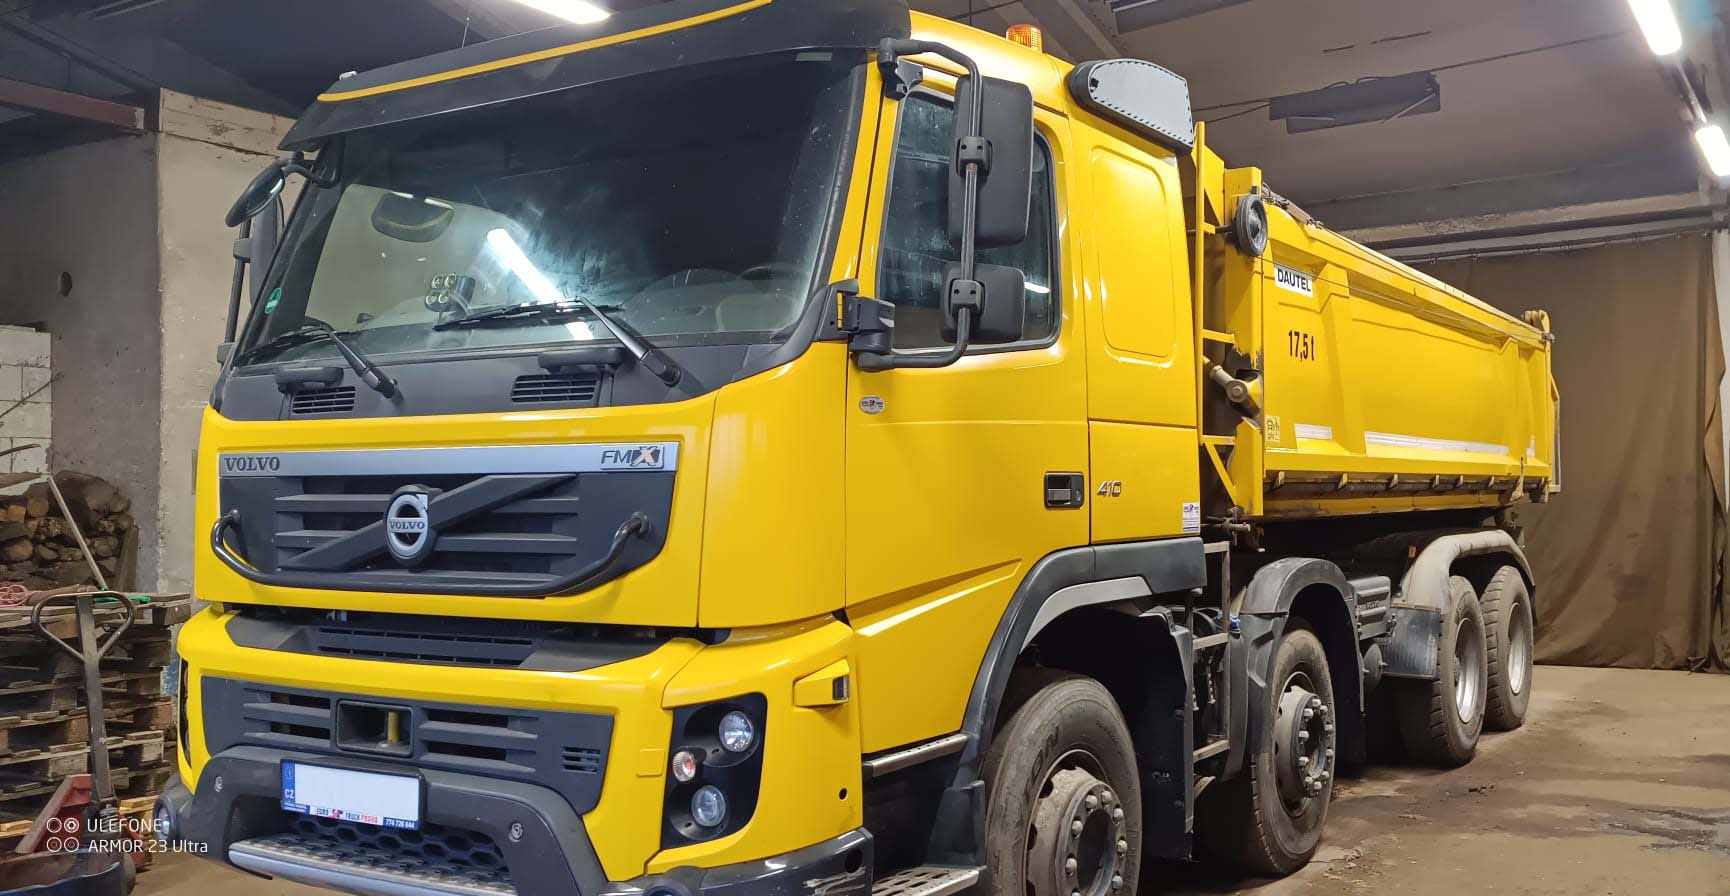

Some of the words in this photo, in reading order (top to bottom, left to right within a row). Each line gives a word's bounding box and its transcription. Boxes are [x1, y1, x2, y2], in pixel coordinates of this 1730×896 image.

[1277, 268, 1312, 292] DAUTEL
[1288, 330, 1308, 361] 17,5
[224, 456, 281, 472] VOLVO
[600, 446, 660, 467] FMX
[1096, 480, 1122, 498] 410
[389, 521, 426, 530] VOLVO
[284, 788, 295, 799] CZ
